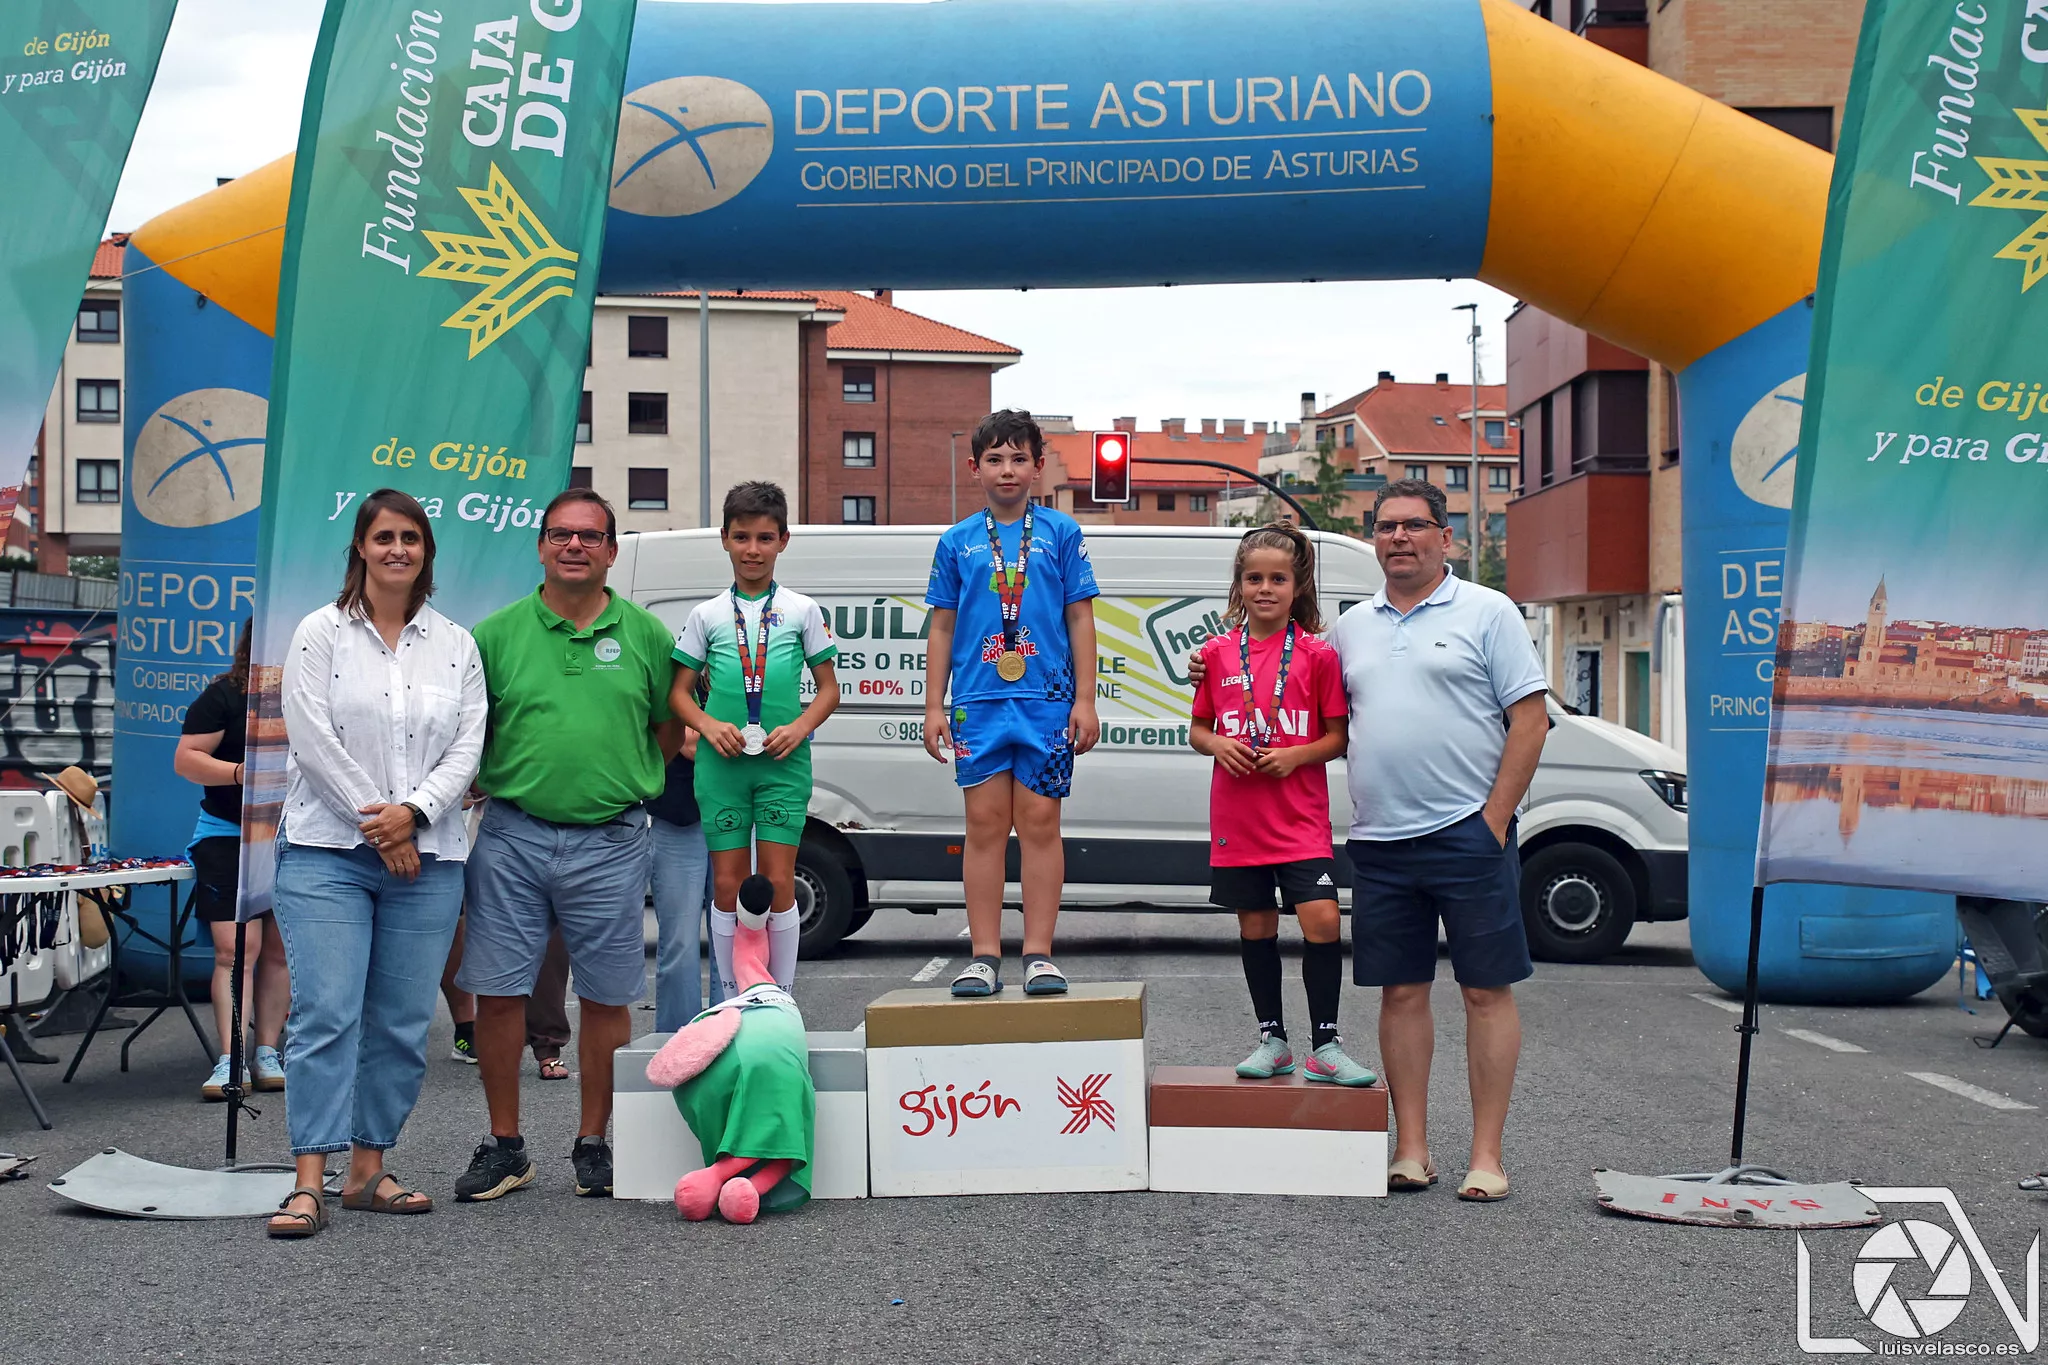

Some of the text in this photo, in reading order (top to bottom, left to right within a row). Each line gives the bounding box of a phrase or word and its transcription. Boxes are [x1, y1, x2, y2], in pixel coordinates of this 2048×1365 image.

[24, 29, 111, 56] de Gijón
[2, 58, 127, 94] y para Gijón
[461, 15, 518, 147] CAJA
[511, 52, 574, 158] DE
[795, 69, 1432, 135] DEPORTE ASTURIANO
[362, 9, 443, 275] Fundación
[800, 147, 1419, 191] GOBIERNO DEL PRINCIPADO DE ASTURIAS
[1915, 376, 1965, 408] de
[371, 437, 527, 481] de Gijón
[1867, 431, 1898, 462] y
[1899, 433, 1990, 464] para
[328, 491, 356, 521] y
[994, 555, 1003, 572] RFEP
[1018, 555, 1026, 572] RFEP
[1722, 561, 1781, 599] DE
[1002, 602, 1010, 619] RFEP
[1010, 603, 1018, 620] RFEP
[737, 628, 746, 645] RFEP
[759, 627, 767, 644] RFEP
[1722, 607, 1781, 645] AS
[1284, 634, 1292, 651] RFEP
[875, 653, 890, 670] O
[744, 675, 753, 693] RFEP
[753, 674, 762, 693] RFEP
[859, 680, 904, 695] 60%
[1242, 674, 1250, 691] RFEP
[1274, 679, 1284, 696] RFEP
[899, 1079, 1018, 1137] gijón
